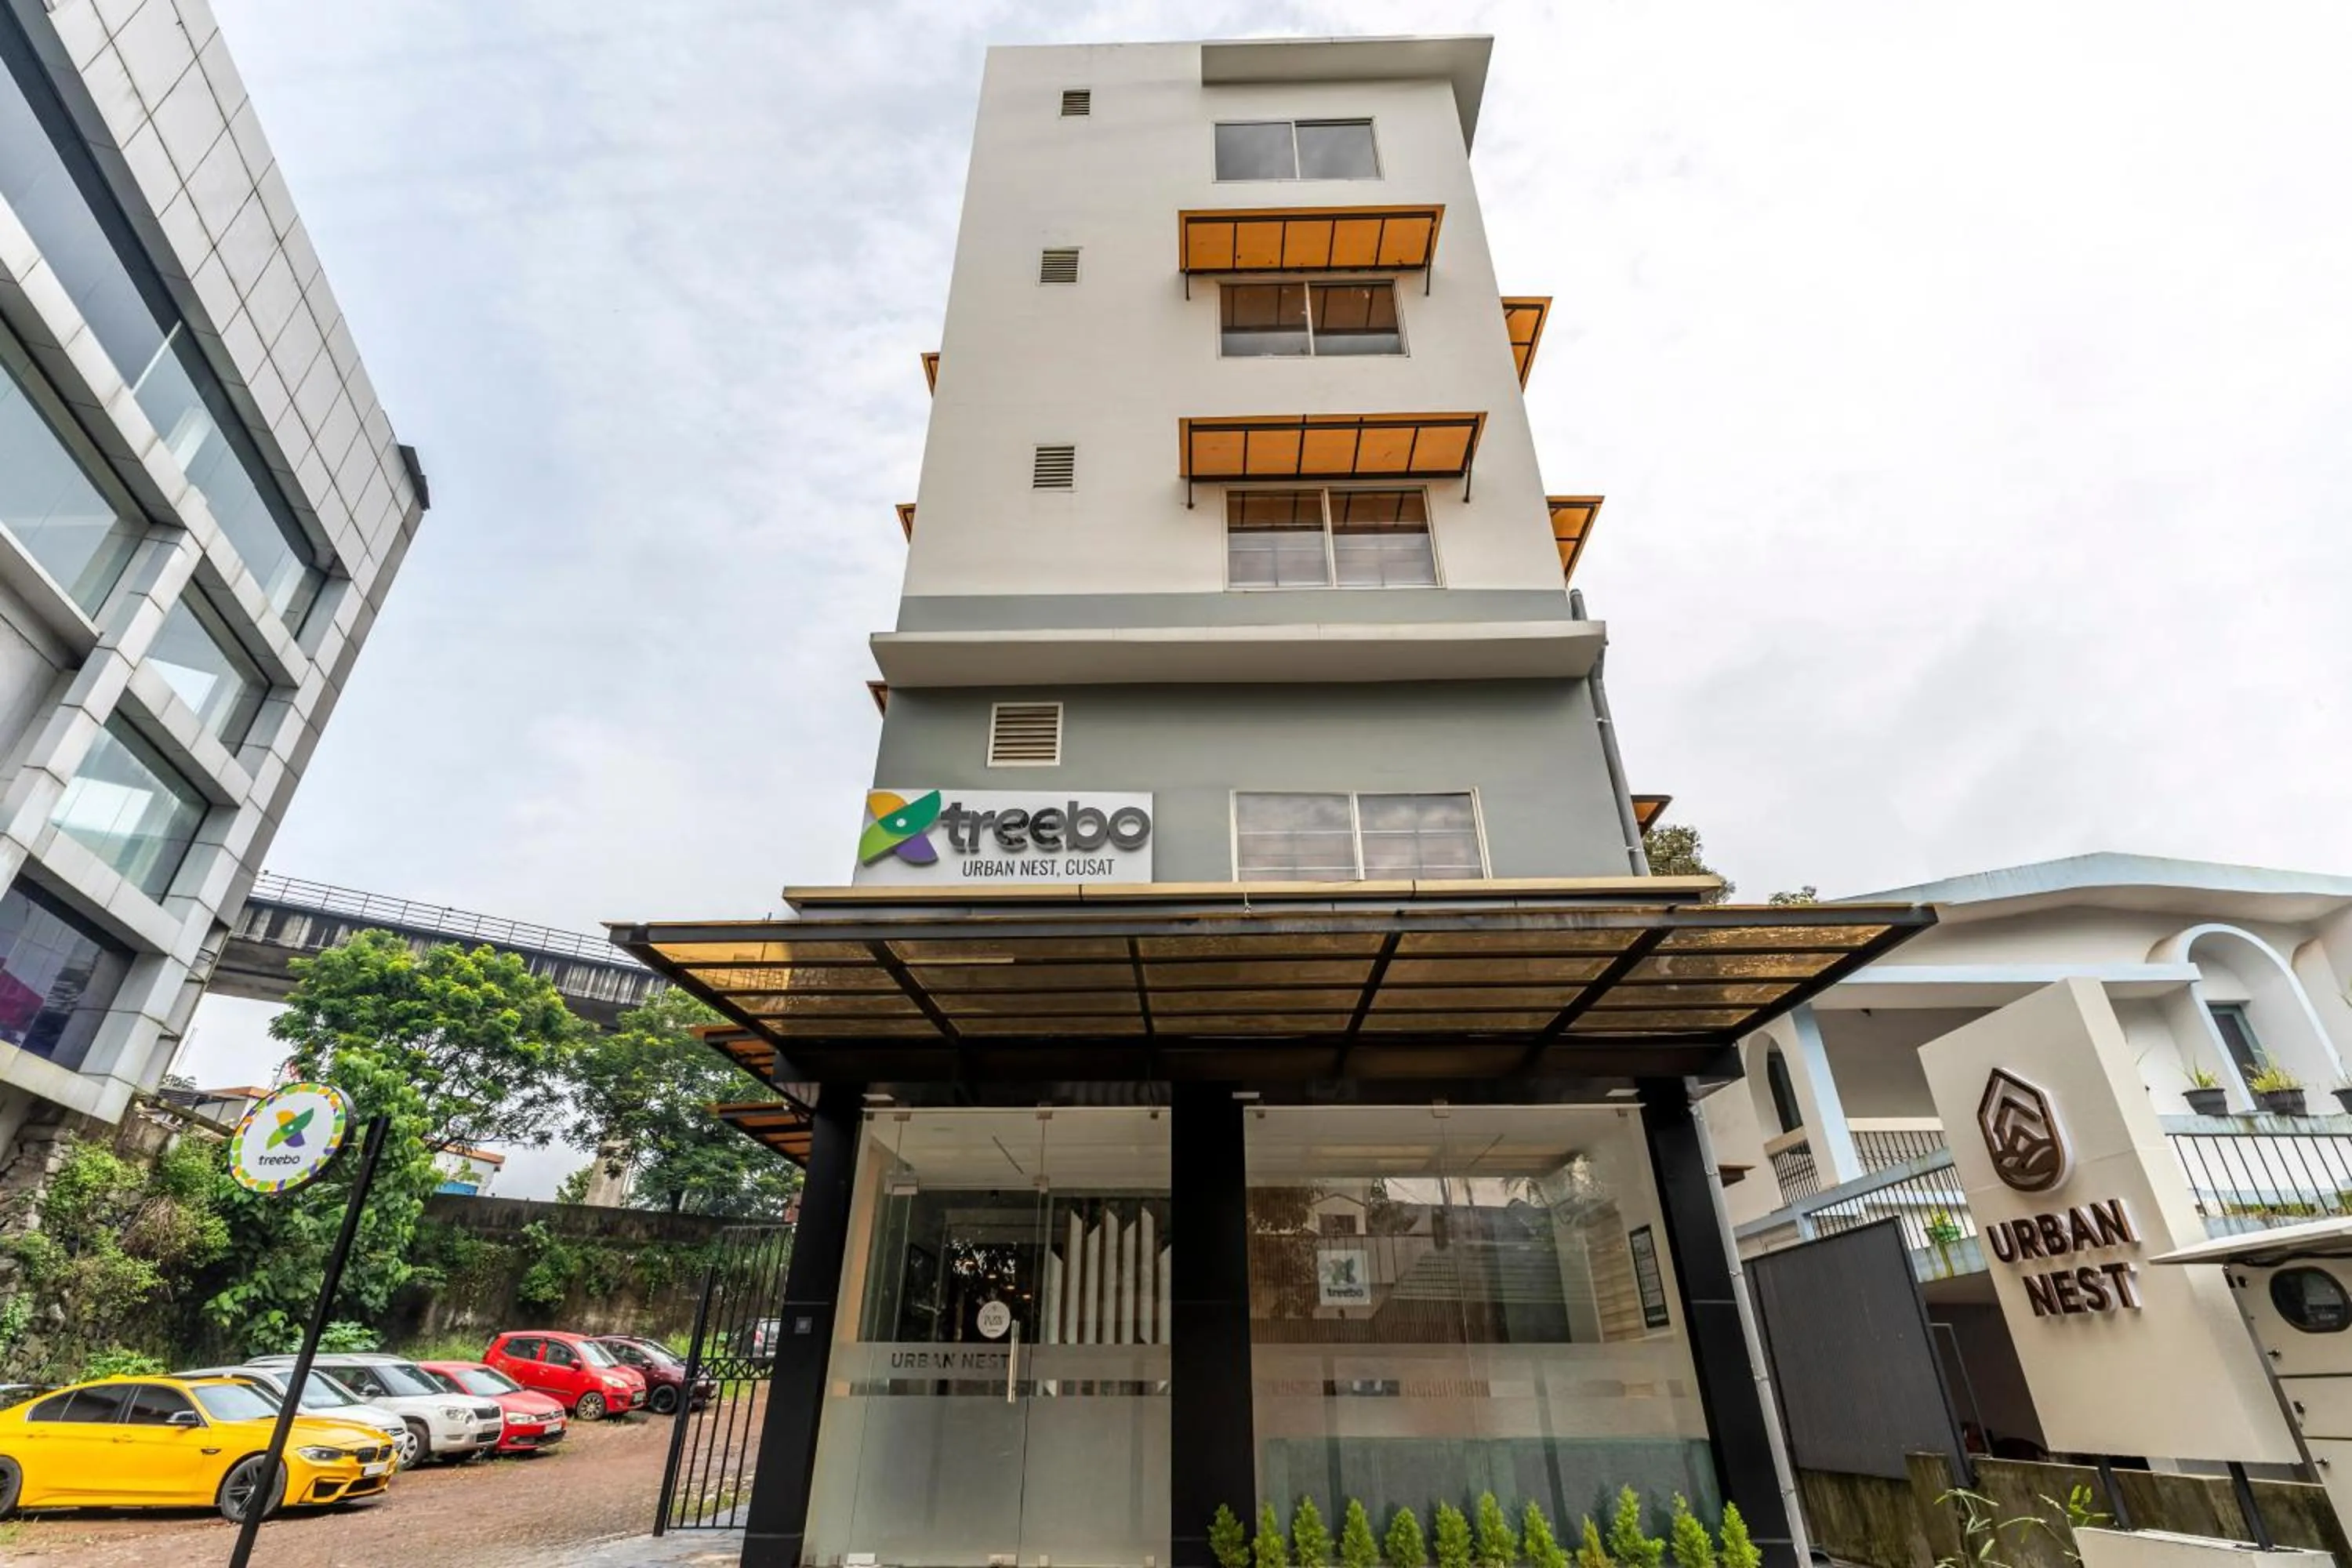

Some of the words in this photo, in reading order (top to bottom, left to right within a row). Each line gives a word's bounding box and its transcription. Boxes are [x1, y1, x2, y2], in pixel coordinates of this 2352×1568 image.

[940, 800, 1151, 854] treebo
[962, 860, 1015, 877] URBAN
[1020, 859, 1061, 877] NEST,
[1065, 858, 1115, 876] CUSAT
[258, 1154, 300, 1166] treebo
[1986, 1199, 2141, 1263] URBAN
[1327, 1287, 1364, 1298] treebo
[2022, 1262, 2142, 1316] NEST
[891, 1352, 956, 1369] URBAN
[962, 1354, 1011, 1369] NEST
